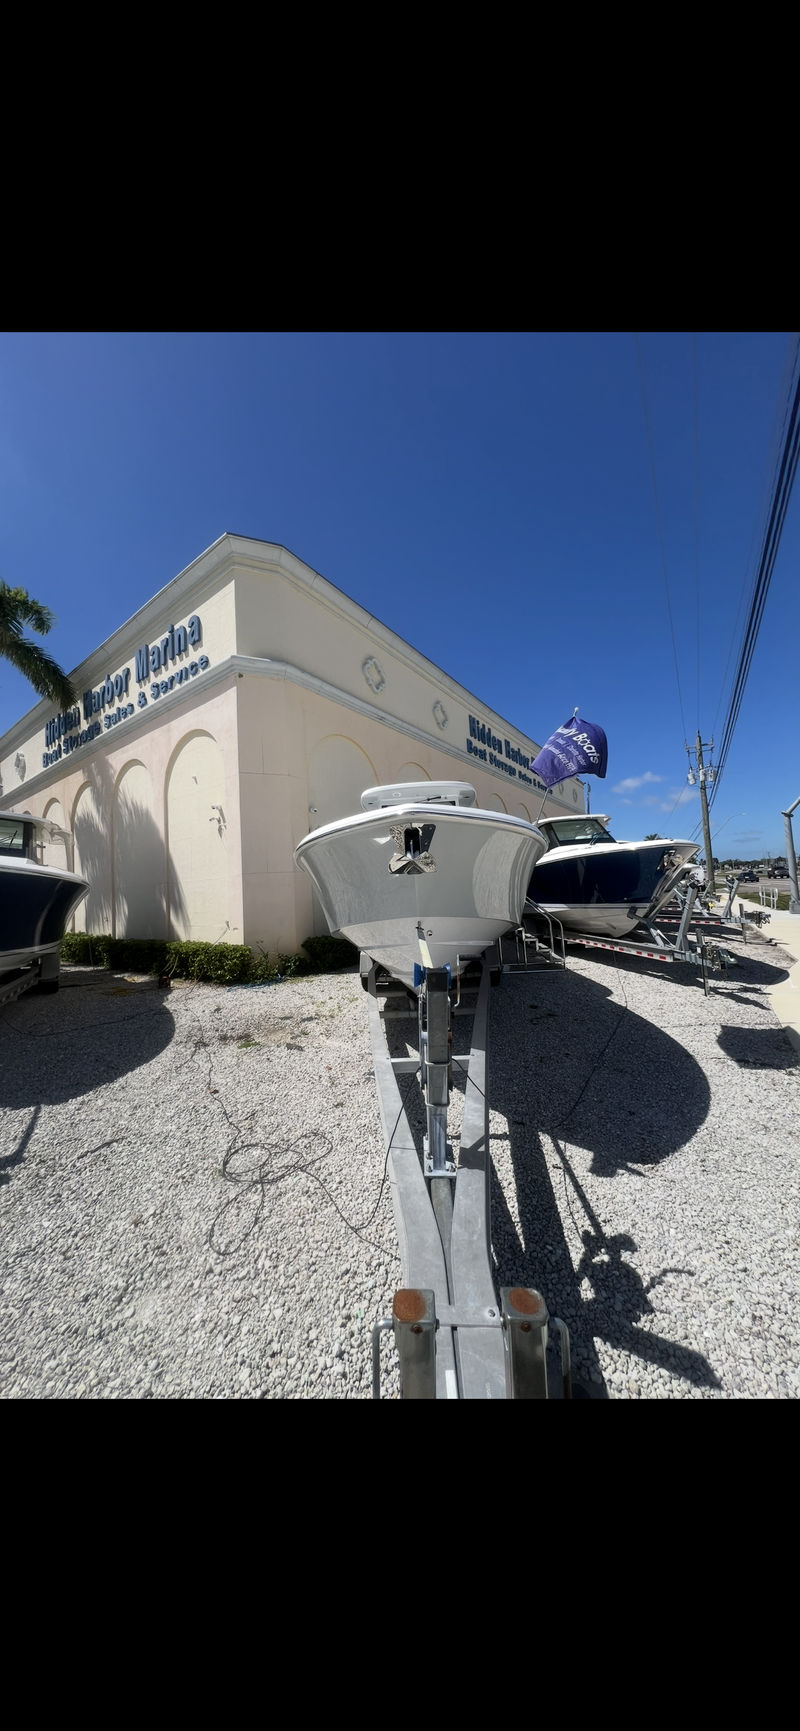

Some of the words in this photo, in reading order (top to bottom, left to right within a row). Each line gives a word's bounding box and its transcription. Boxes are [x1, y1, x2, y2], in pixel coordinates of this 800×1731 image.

[45, 706, 80, 748] Hidden
[83, 667, 131, 720] Harbor
[135, 615, 202, 683] Marina
[43, 744, 62, 768] Boat
[63, 722, 101, 755] Storage
[104, 703, 134, 729] Sales
[137, 691, 147, 708] &
[151, 655, 209, 700] Service
[469, 714, 503, 755] Hidden
[572, 732, 600, 764] Boats
[466, 738, 488, 762] Boat
[489, 752, 517, 777] Storage
